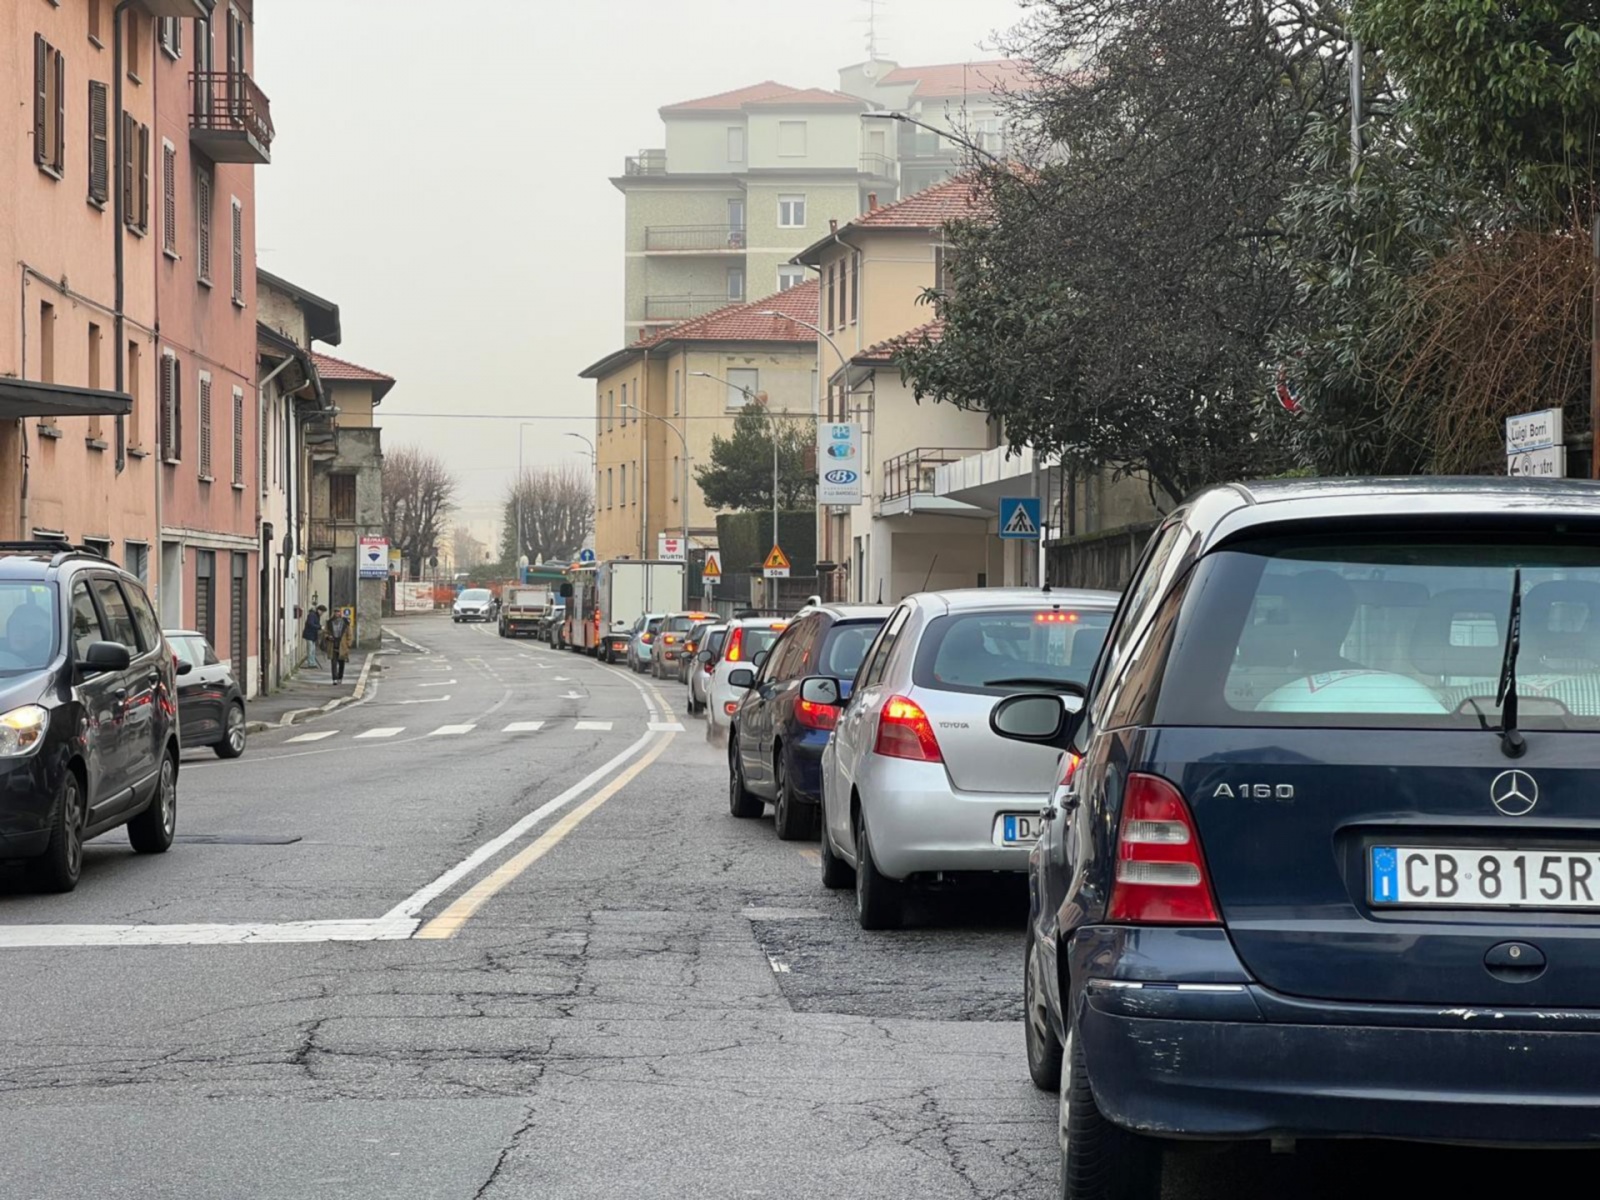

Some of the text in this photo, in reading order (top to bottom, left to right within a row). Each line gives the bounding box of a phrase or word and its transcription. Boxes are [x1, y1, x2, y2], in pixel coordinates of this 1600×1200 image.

[1511, 421, 1547, 441] Luigi Borri
[1477, 855, 1600, 901] 815R
